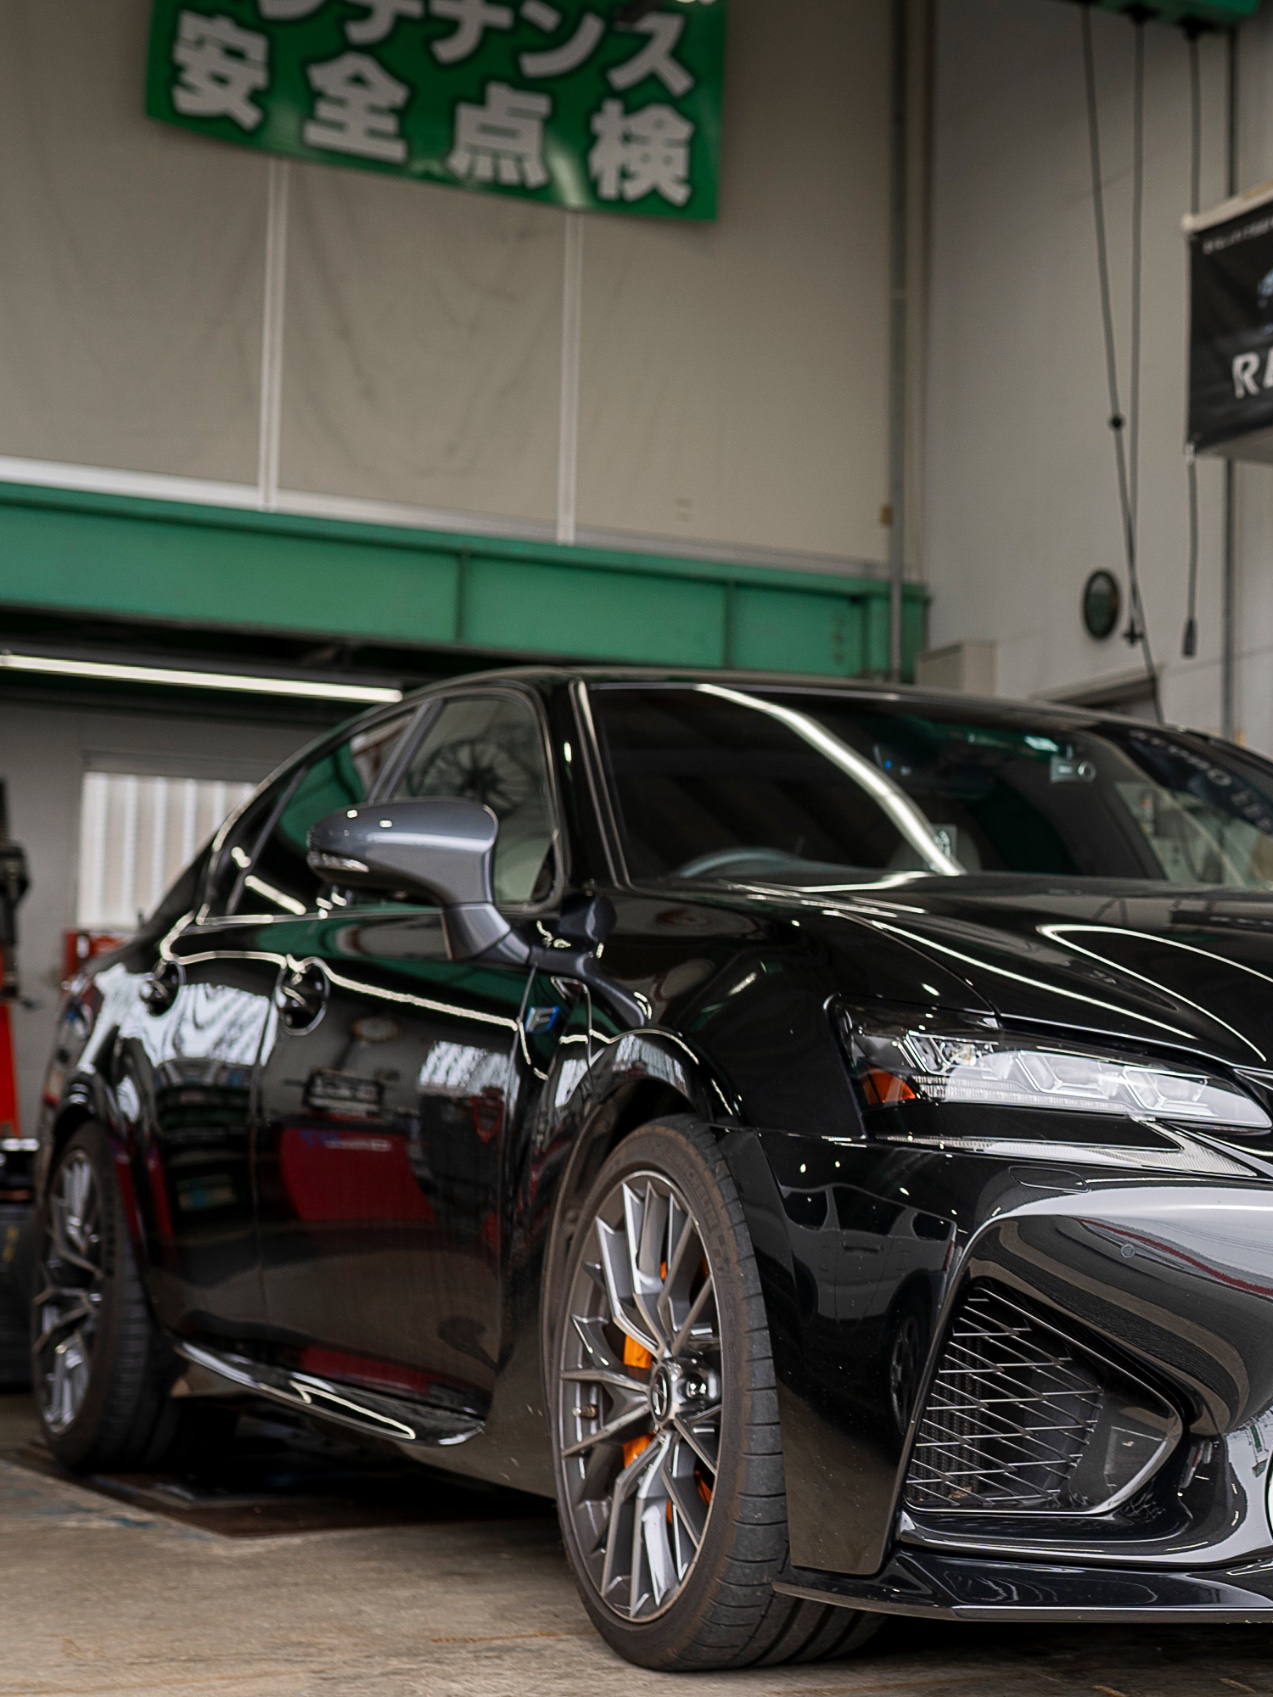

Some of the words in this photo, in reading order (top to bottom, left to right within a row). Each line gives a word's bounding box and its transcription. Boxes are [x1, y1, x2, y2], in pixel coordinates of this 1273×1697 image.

[171, 10, 696, 208] 安全点検
[260, 0, 696, 97] テナンス
